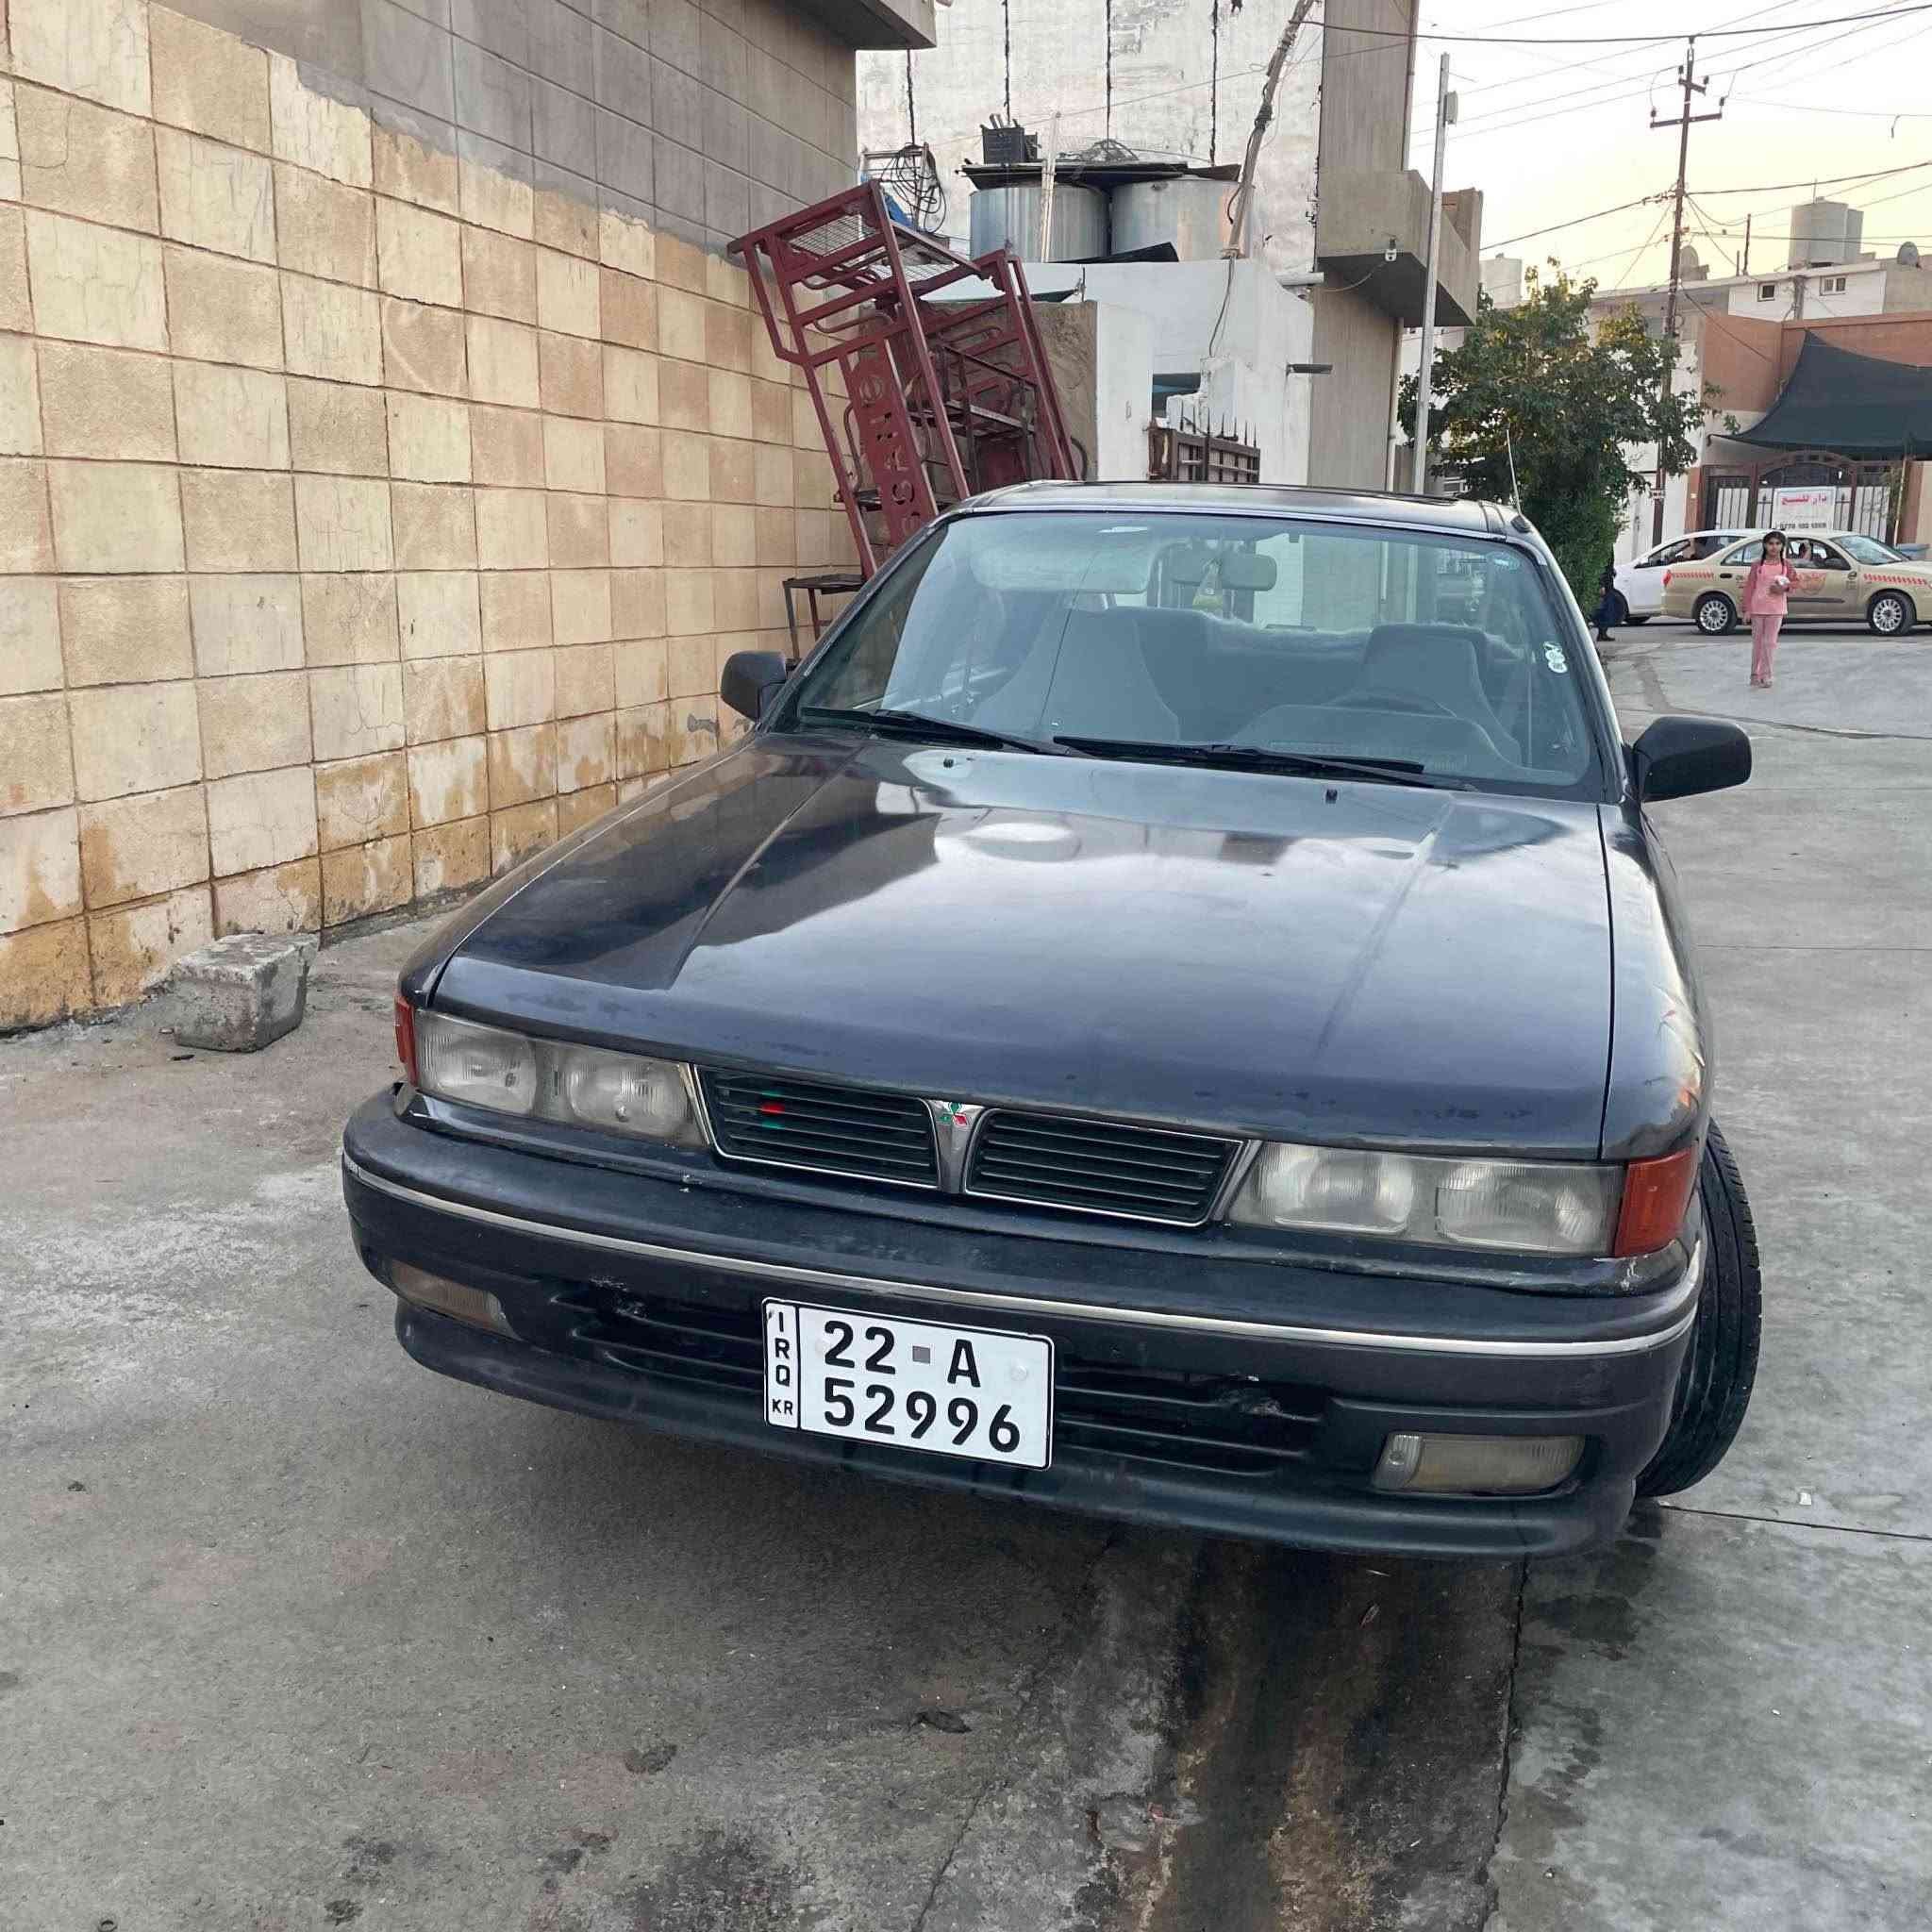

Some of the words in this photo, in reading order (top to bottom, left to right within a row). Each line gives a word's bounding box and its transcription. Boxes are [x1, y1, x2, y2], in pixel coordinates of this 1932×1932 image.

[774, 1311, 791, 1387] IRQ
[824, 1321, 896, 1374] 22
[946, 1338, 982, 1389] A
[772, 1398, 794, 1416] KR
[824, 1377, 1021, 1453] 52996
